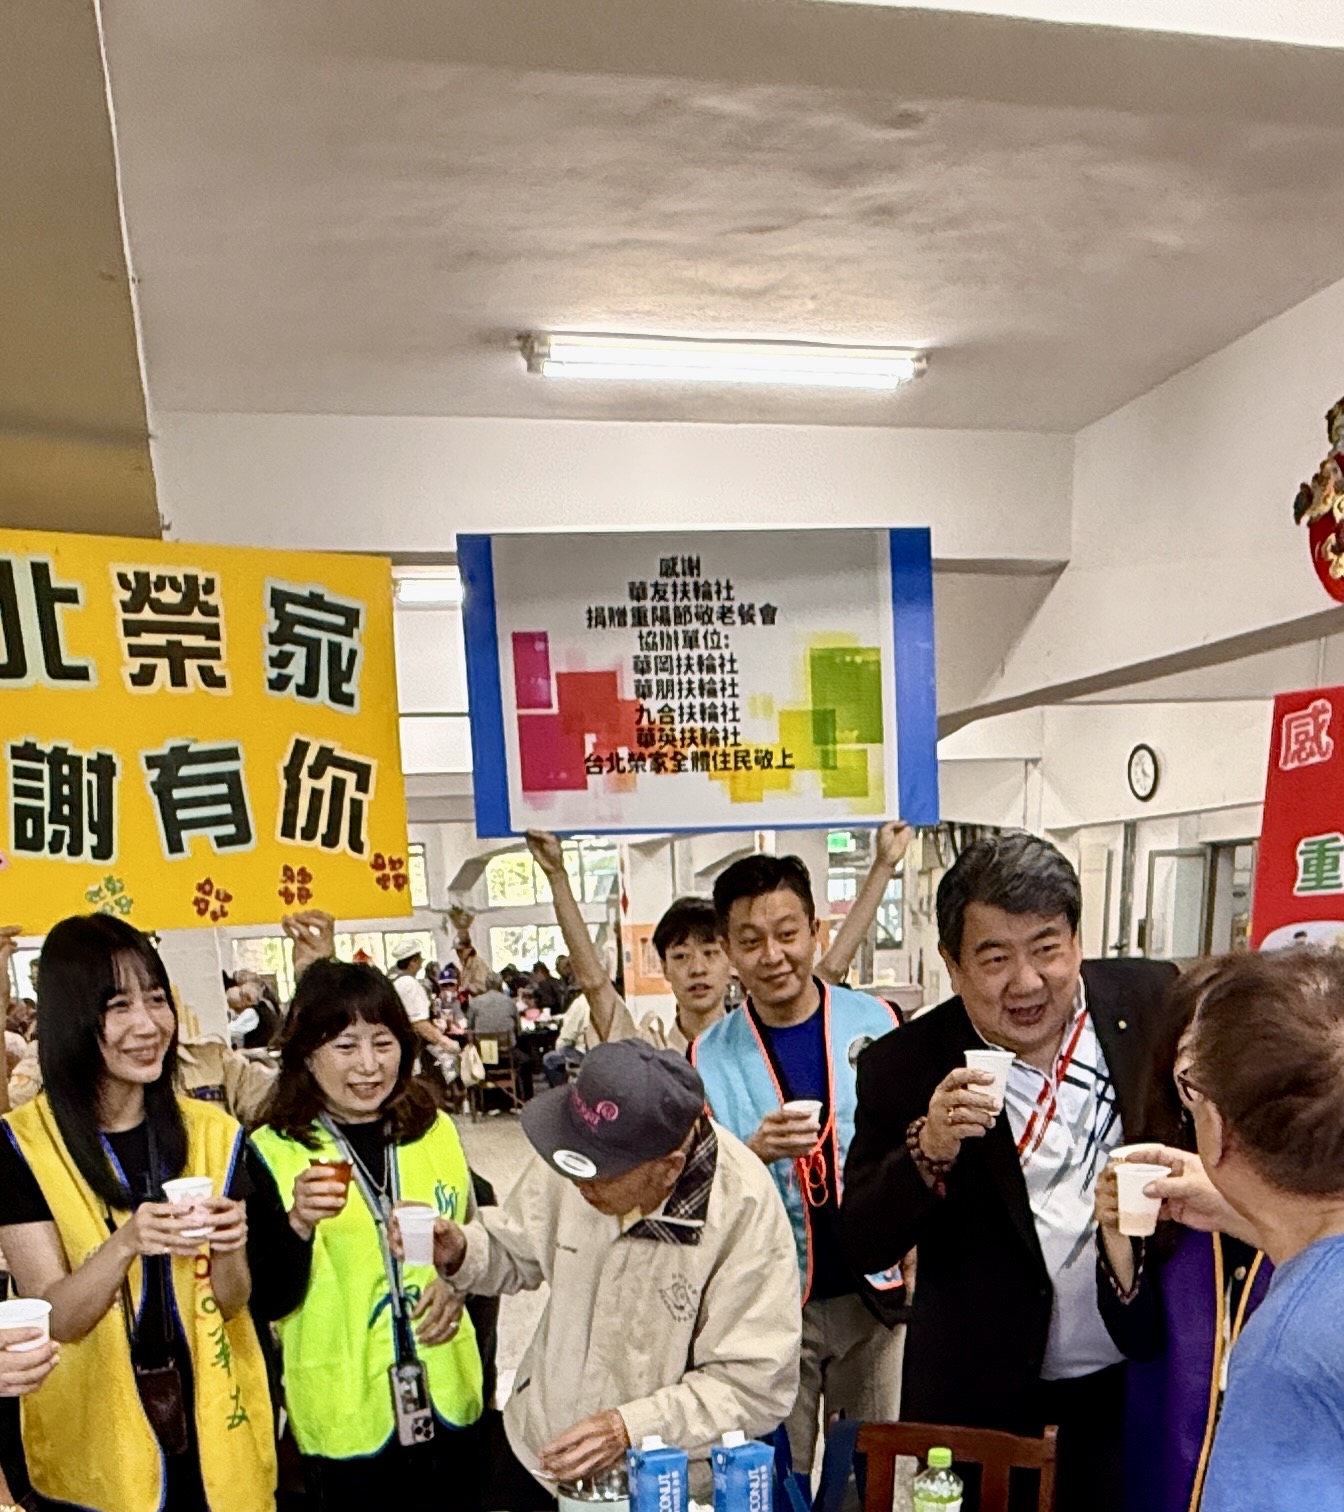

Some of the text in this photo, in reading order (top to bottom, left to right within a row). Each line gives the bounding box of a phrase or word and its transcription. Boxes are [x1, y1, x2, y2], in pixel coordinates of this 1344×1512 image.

[659, 555, 702, 579] 感謝
[627, 579, 736, 603] 華友扶輪社
[586, 603, 779, 629] 捐贈重陽節敬老餐會
[633, 677, 740, 700] 華朋扶輪社
[634, 701, 741, 726] 九合扶輪社
[636, 726, 742, 749] 華英扶輪社
[584, 748, 796, 776] 台北榮家全體住民敬上
